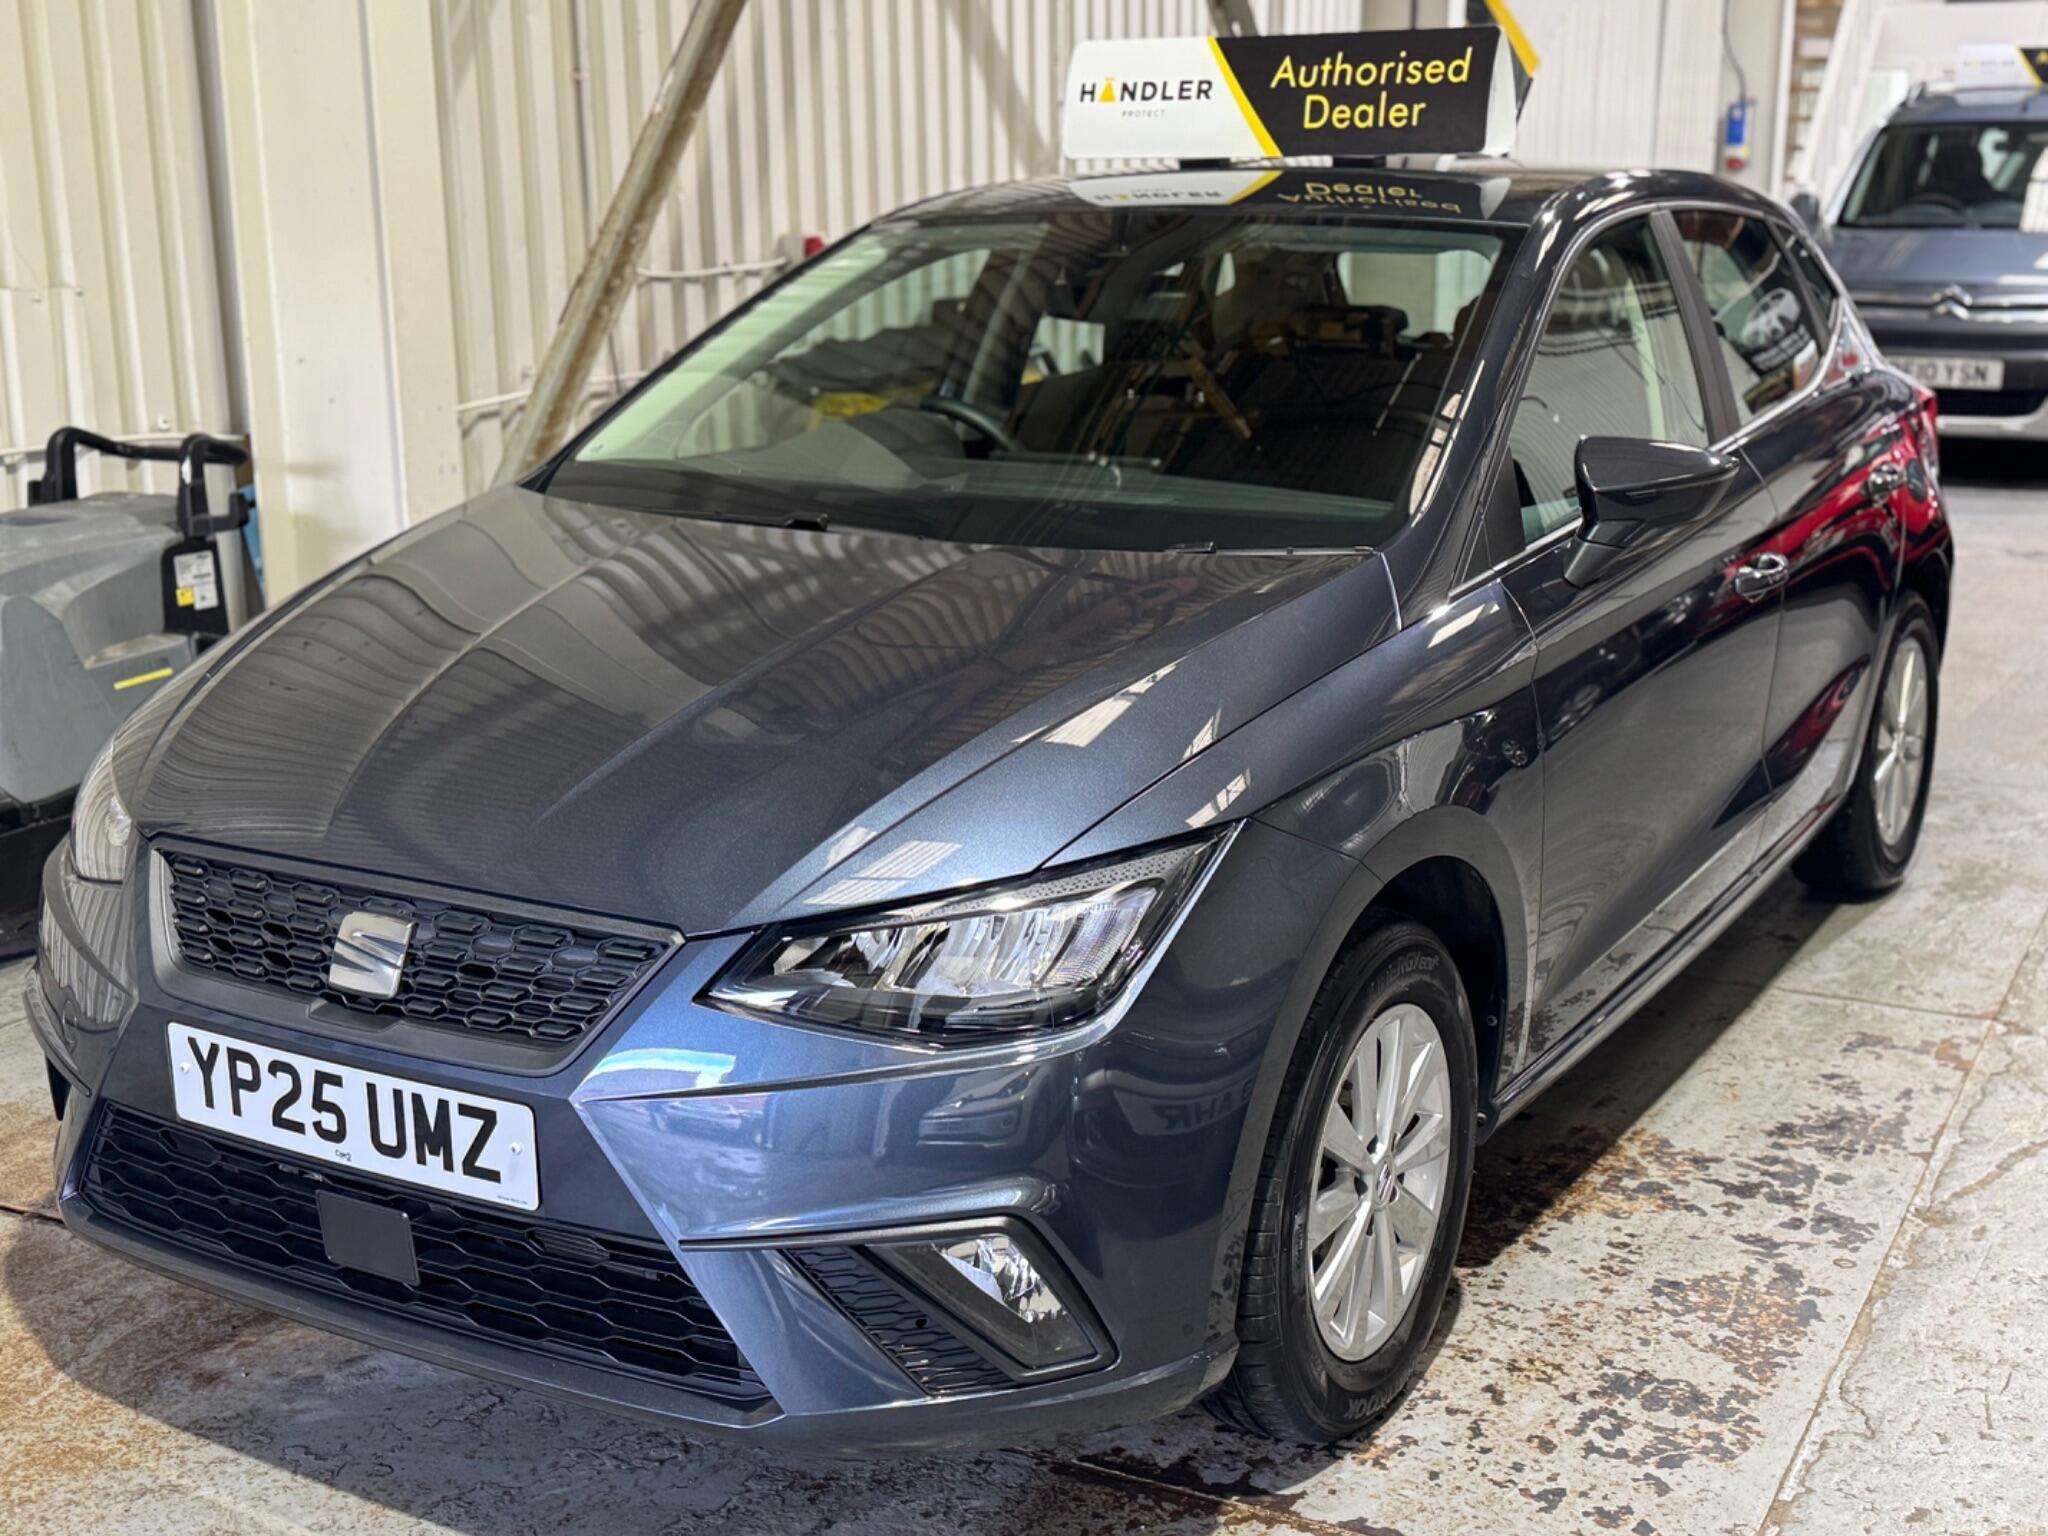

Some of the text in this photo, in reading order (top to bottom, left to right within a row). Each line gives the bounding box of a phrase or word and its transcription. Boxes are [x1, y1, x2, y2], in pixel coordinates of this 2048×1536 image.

[1269, 46, 1474, 89] Authorised
[1121, 109, 1166, 118] PROTECT
[1303, 90, 1427, 129] Dealer
[1944, 362, 1989, 382] YSN
[187, 1035, 502, 1185] YP25 UMZ
